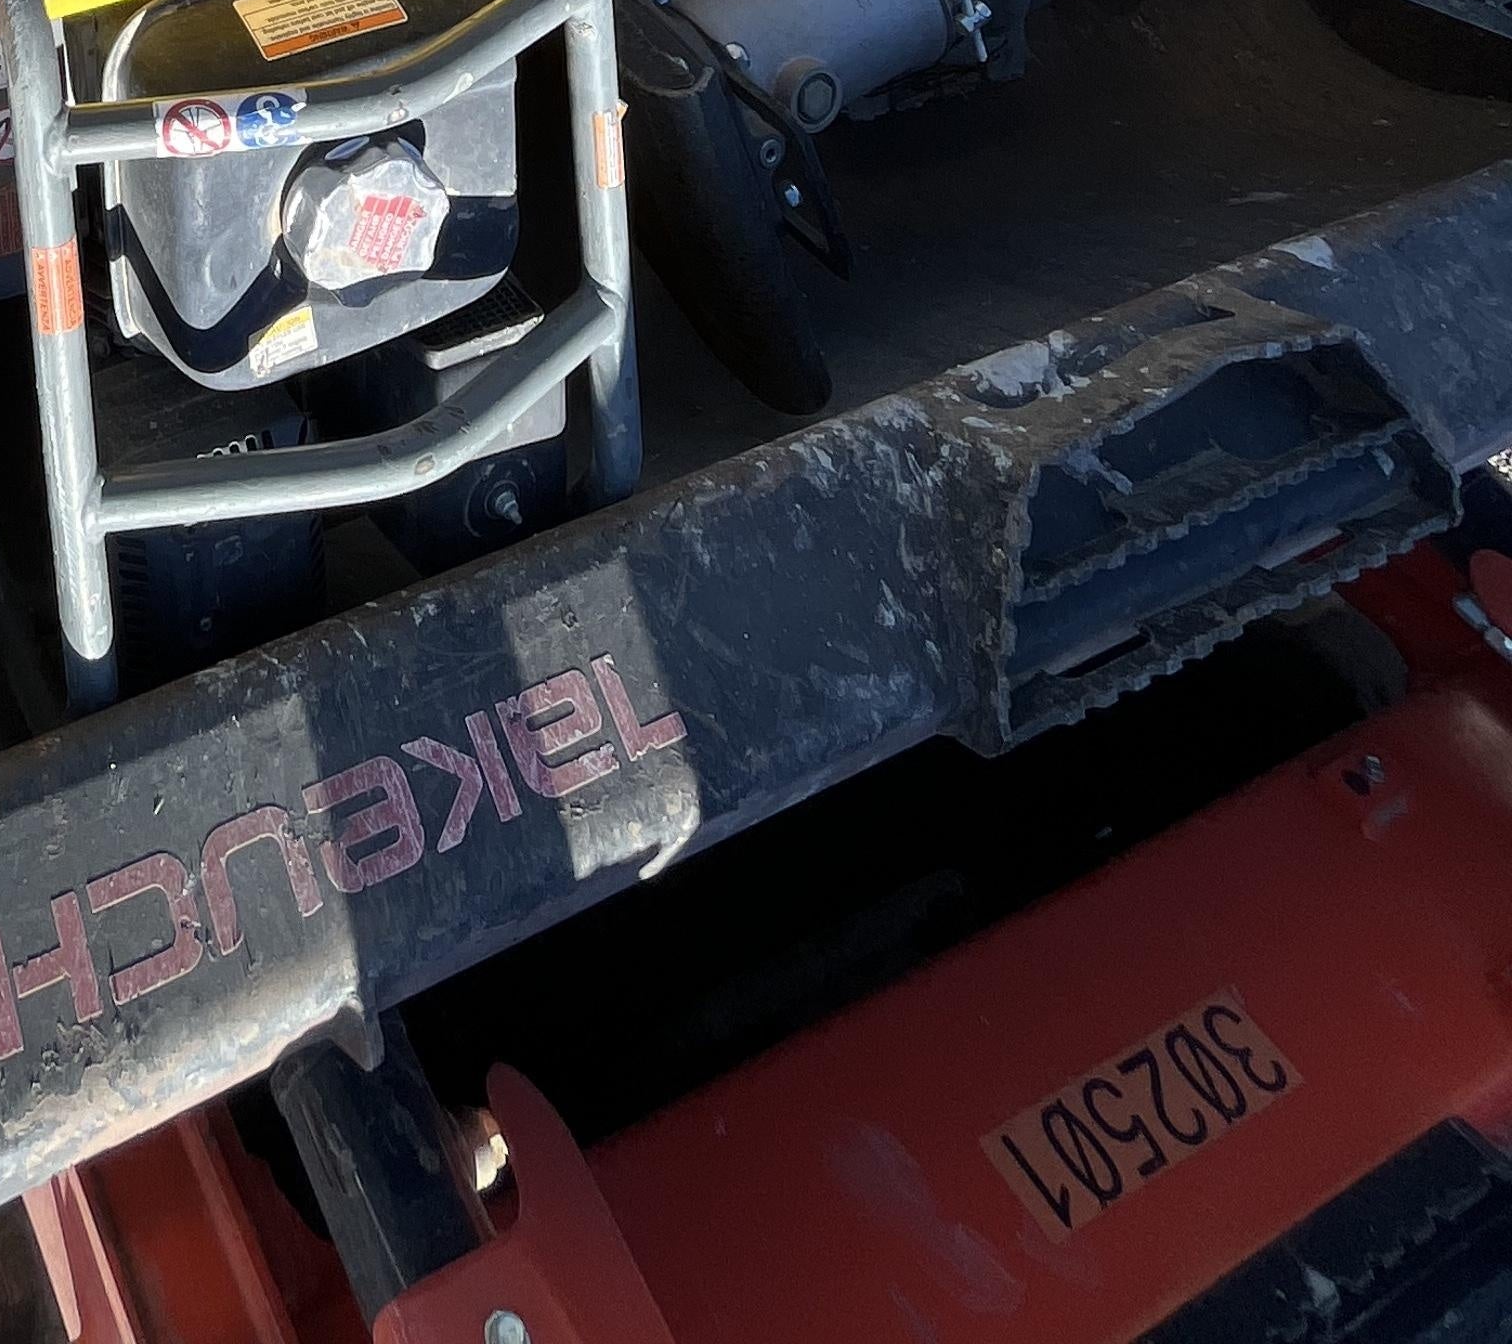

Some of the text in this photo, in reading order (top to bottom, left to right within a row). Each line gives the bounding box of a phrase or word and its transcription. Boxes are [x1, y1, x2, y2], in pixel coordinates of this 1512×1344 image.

[381, 216, 402, 260] DANGER
[37, 263, 50, 331] AVVERTENZA
[1000, 1005, 1288, 1230] 302501
